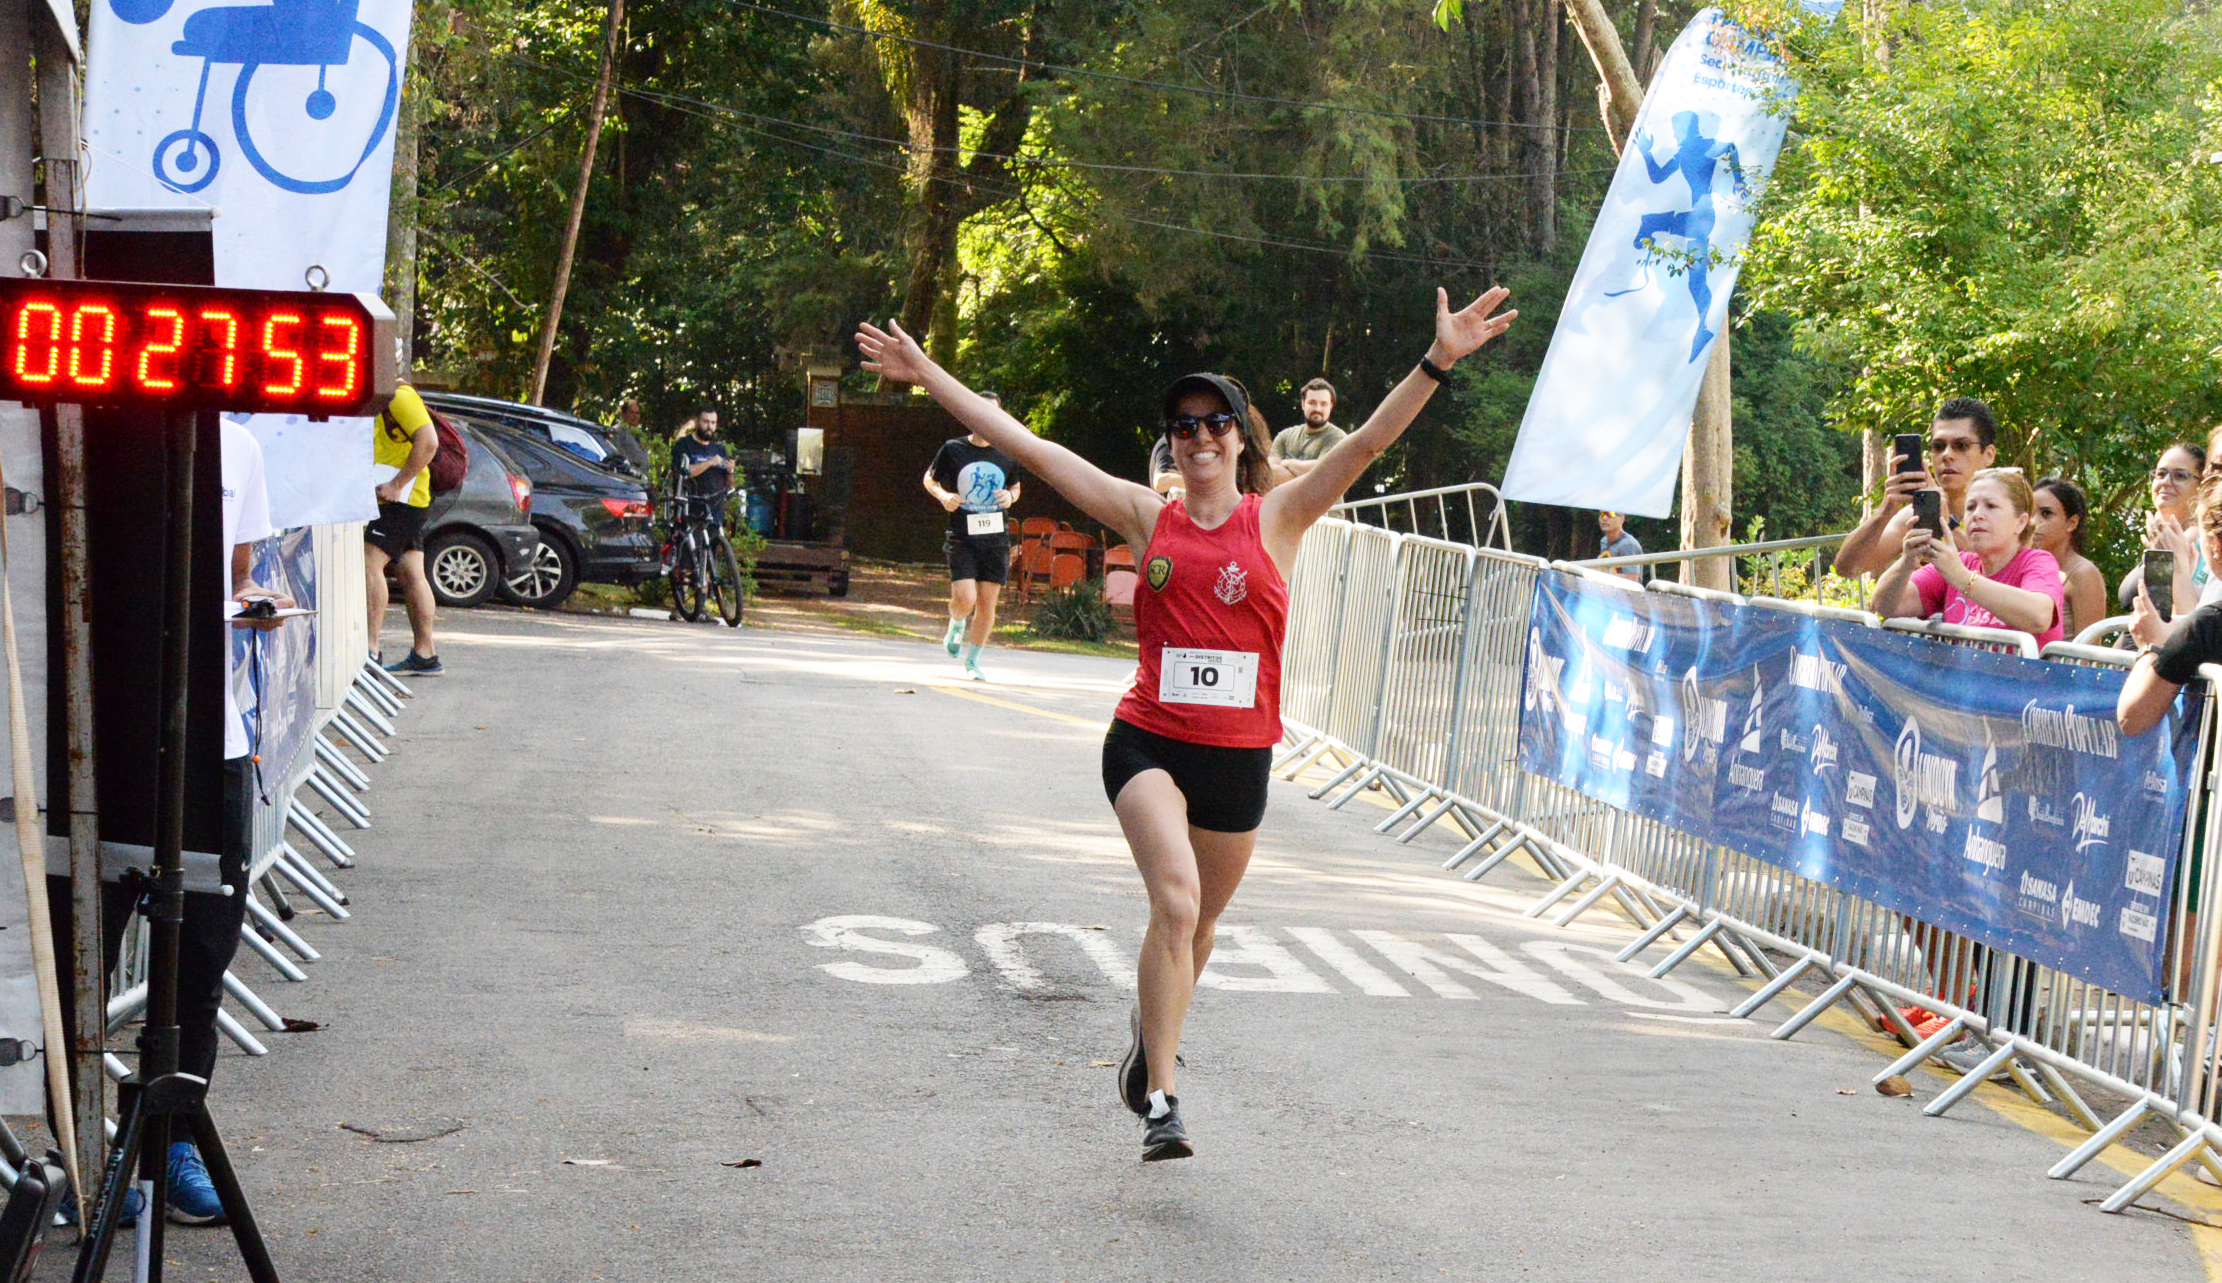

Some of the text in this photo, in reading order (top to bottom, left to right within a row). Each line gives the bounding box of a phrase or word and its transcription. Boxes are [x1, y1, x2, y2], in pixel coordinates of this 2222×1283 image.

[977, 519, 991, 528] 119
[1190, 665, 1219, 687] 10
[2022, 698, 2118, 759] CORREIO POPULAR
[1963, 823, 2007, 876] Anhanguera
[2072, 897, 2101, 929] EMDEC
